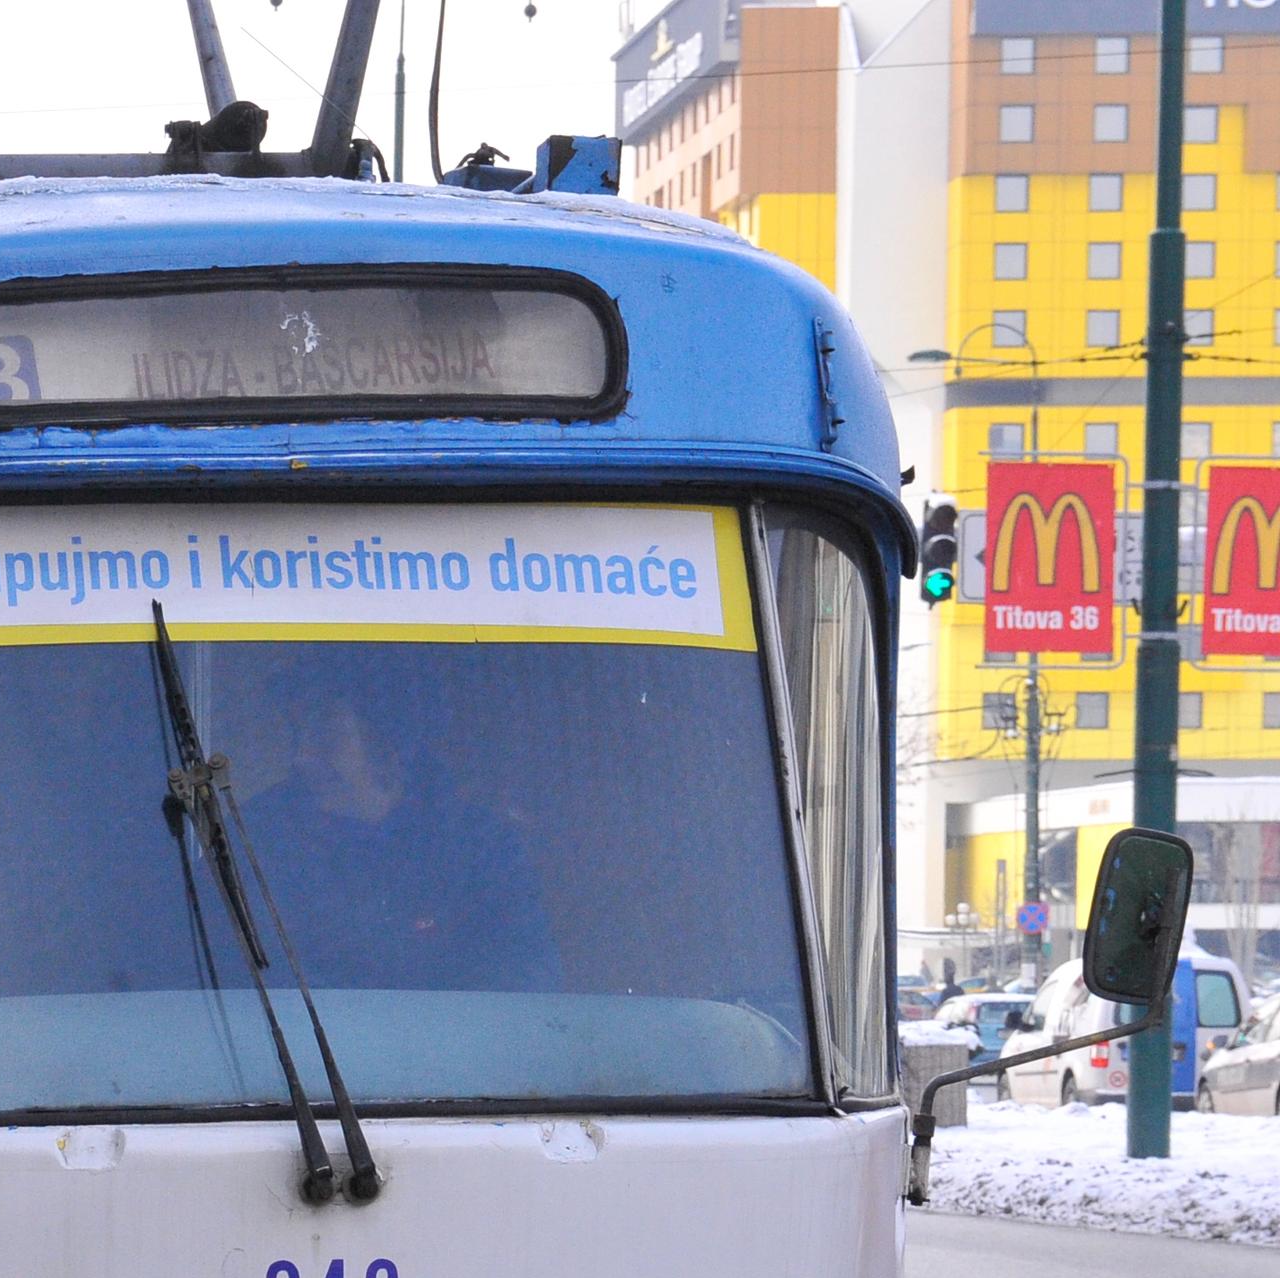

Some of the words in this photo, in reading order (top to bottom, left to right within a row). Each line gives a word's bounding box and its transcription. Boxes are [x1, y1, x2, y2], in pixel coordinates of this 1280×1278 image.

[186, 534, 202, 588] i
[219, 535, 470, 592] koristimo
[490, 537, 698, 599] domaće
[992, 605, 1063, 630] Titova
[1069, 606, 1099, 631] 36
